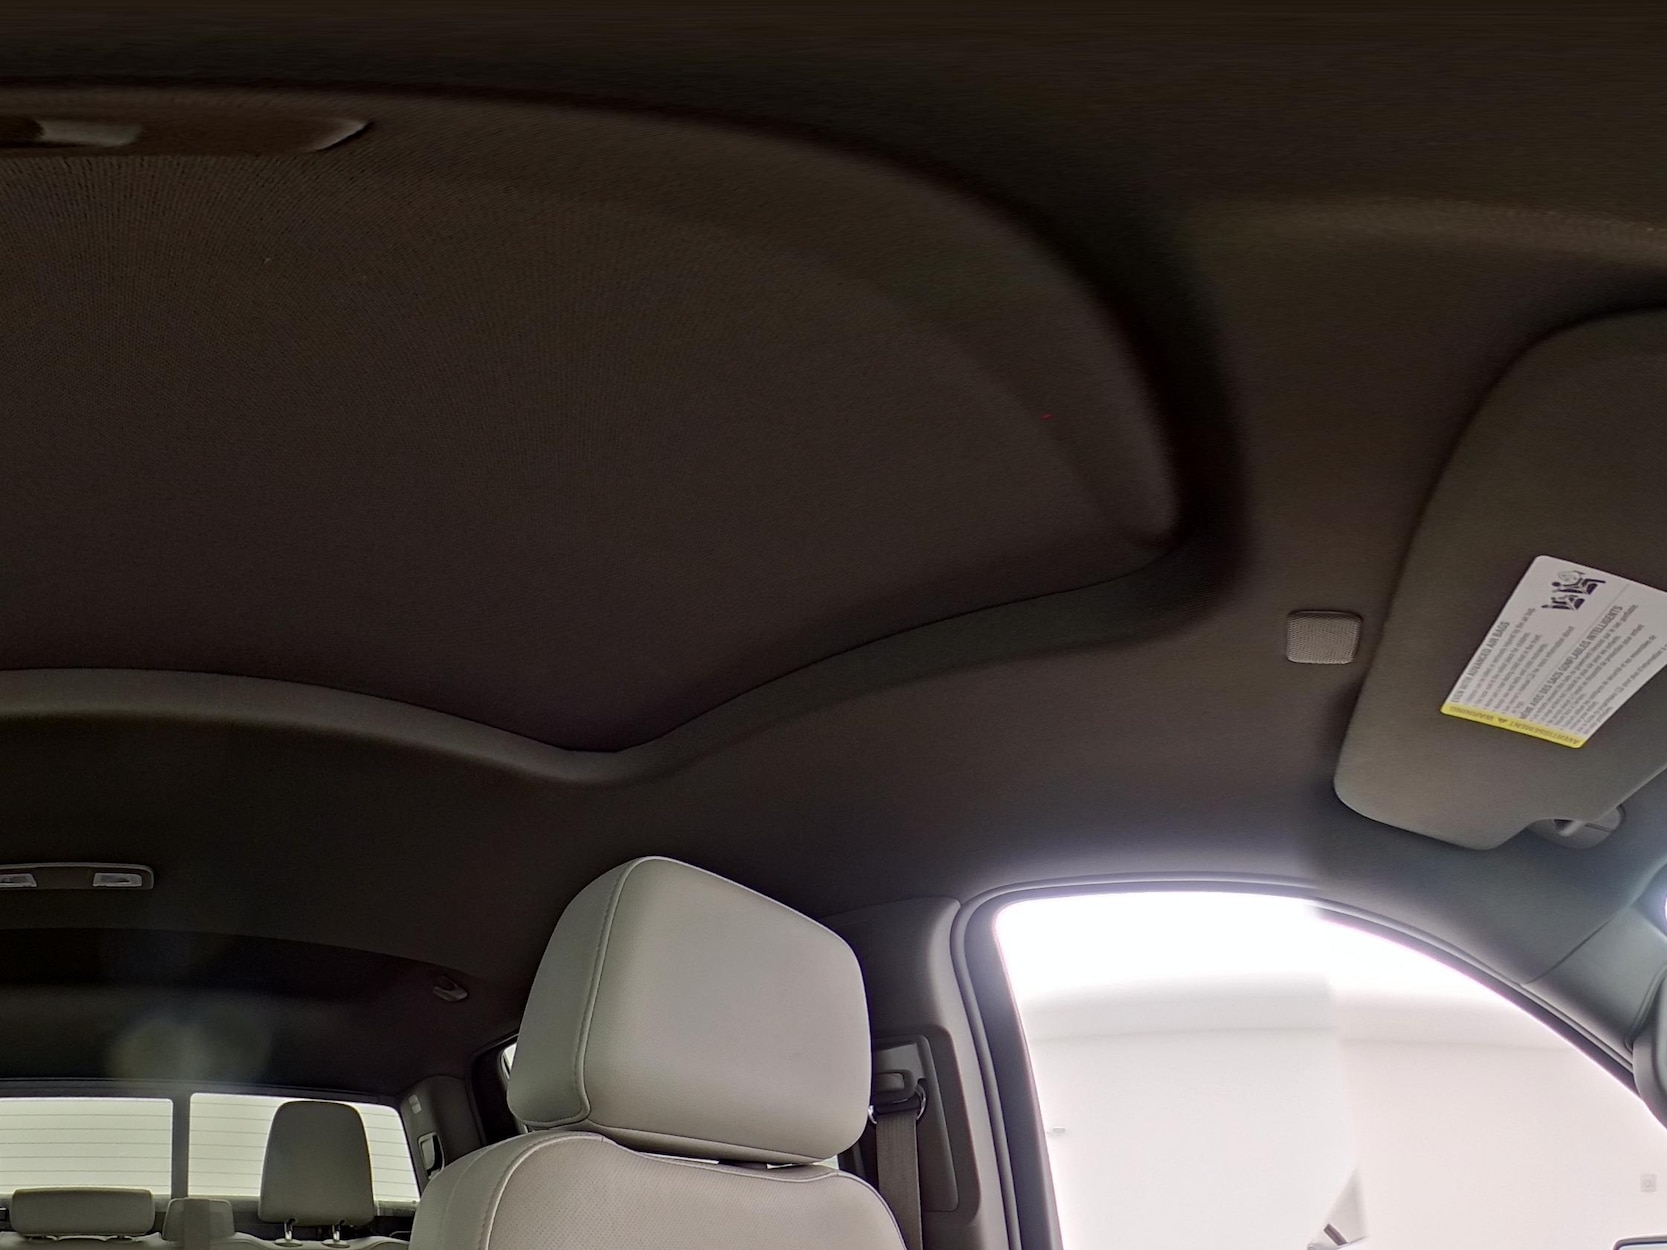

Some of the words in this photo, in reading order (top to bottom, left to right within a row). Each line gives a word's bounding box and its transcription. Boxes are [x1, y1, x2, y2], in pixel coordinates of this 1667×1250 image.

[1491, 619, 1510, 638] BAGS
[1484, 636, 1499, 649] AIR
[1528, 692, 1545, 706] AVEC
[1538, 683, 1553, 694] DES
[1546, 670, 1564, 684] SACS
[1584, 603, 1624, 642] INTELLIGENTS
[1466, 646, 1492, 677] ADVANCED
